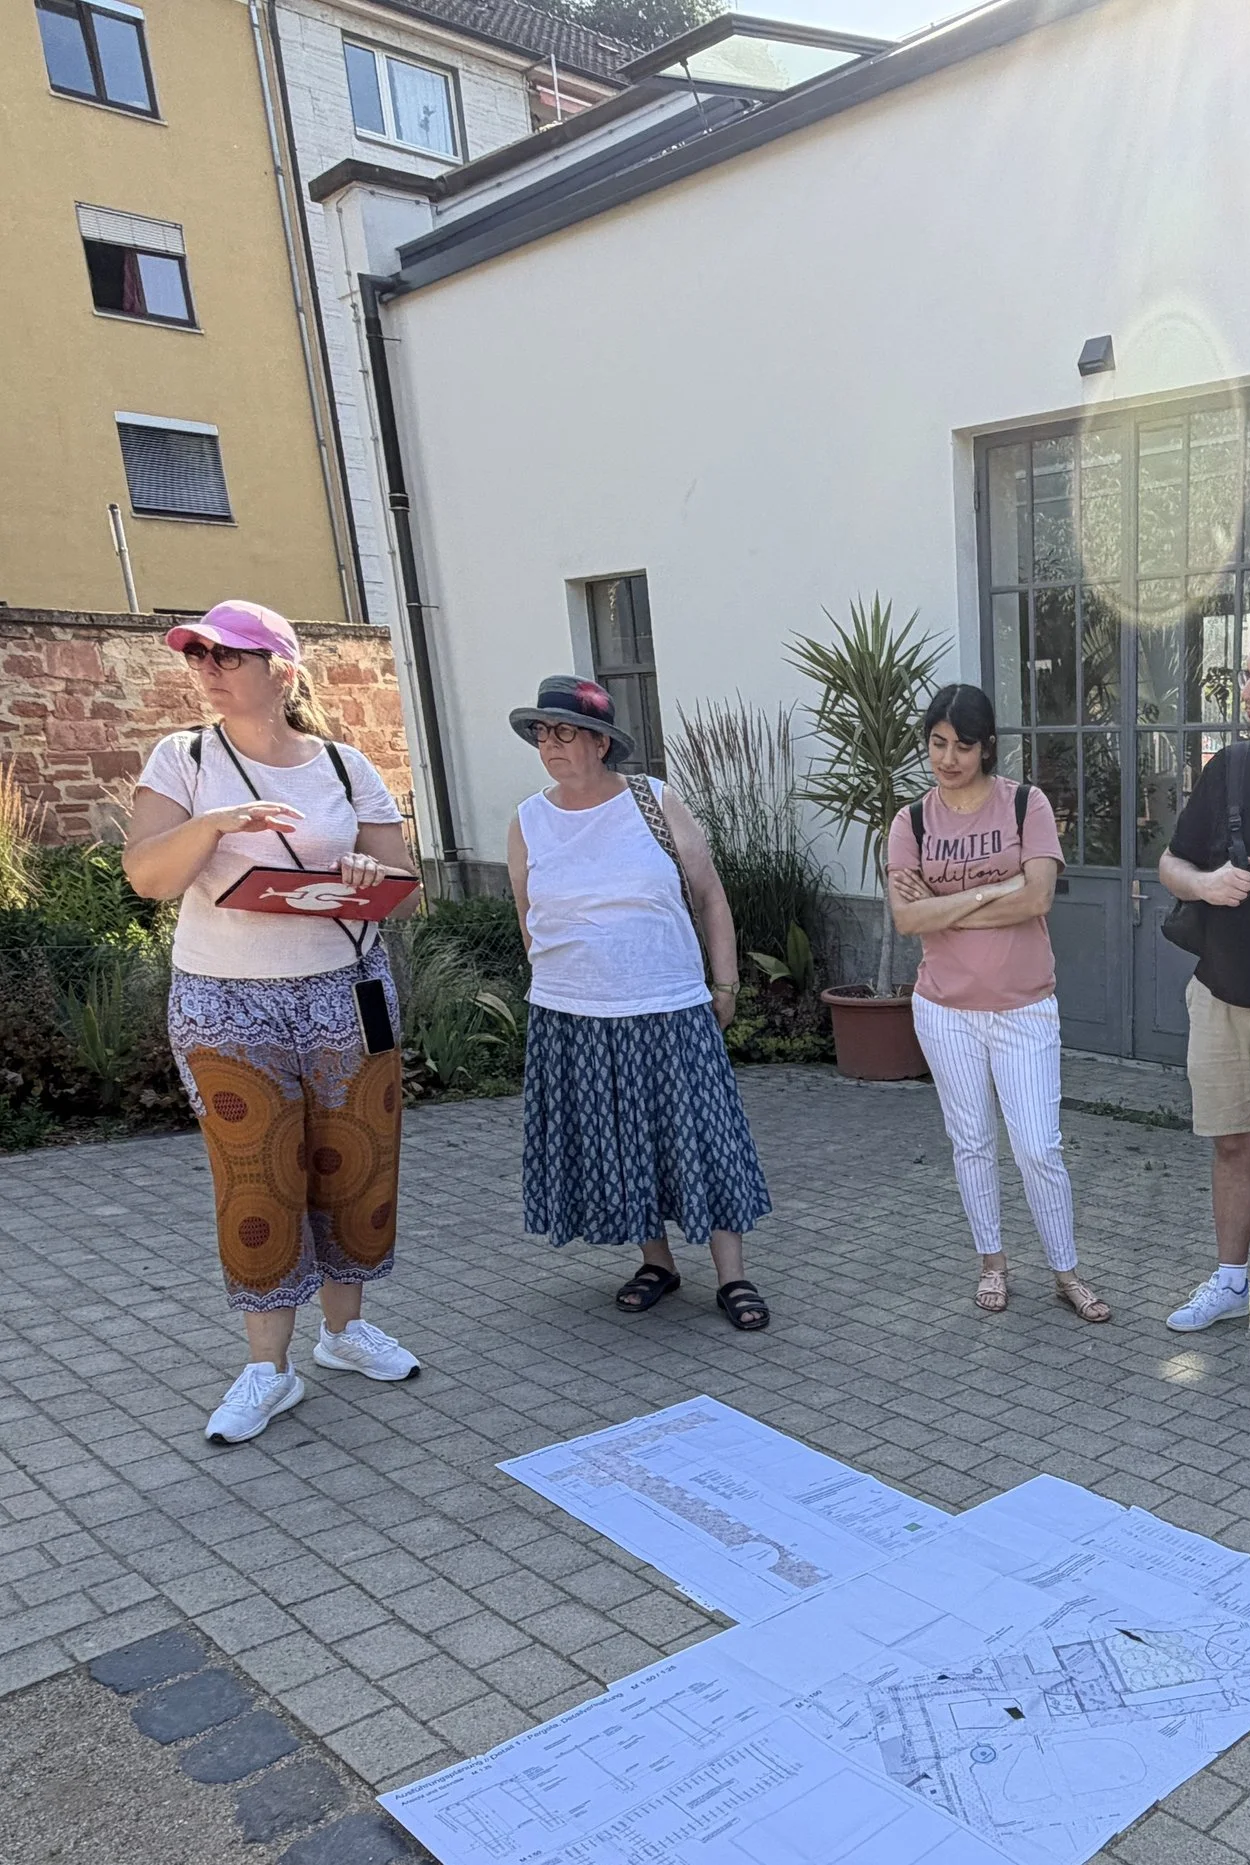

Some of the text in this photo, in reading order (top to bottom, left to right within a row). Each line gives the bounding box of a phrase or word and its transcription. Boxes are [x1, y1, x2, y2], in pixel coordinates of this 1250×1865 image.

[925, 829, 1002, 861] LIMITED
[928, 854, 1008, 890] edition
[395, 1756, 484, 1800] Ausführungsplanung
[490, 1744, 515, 1761] Detail
